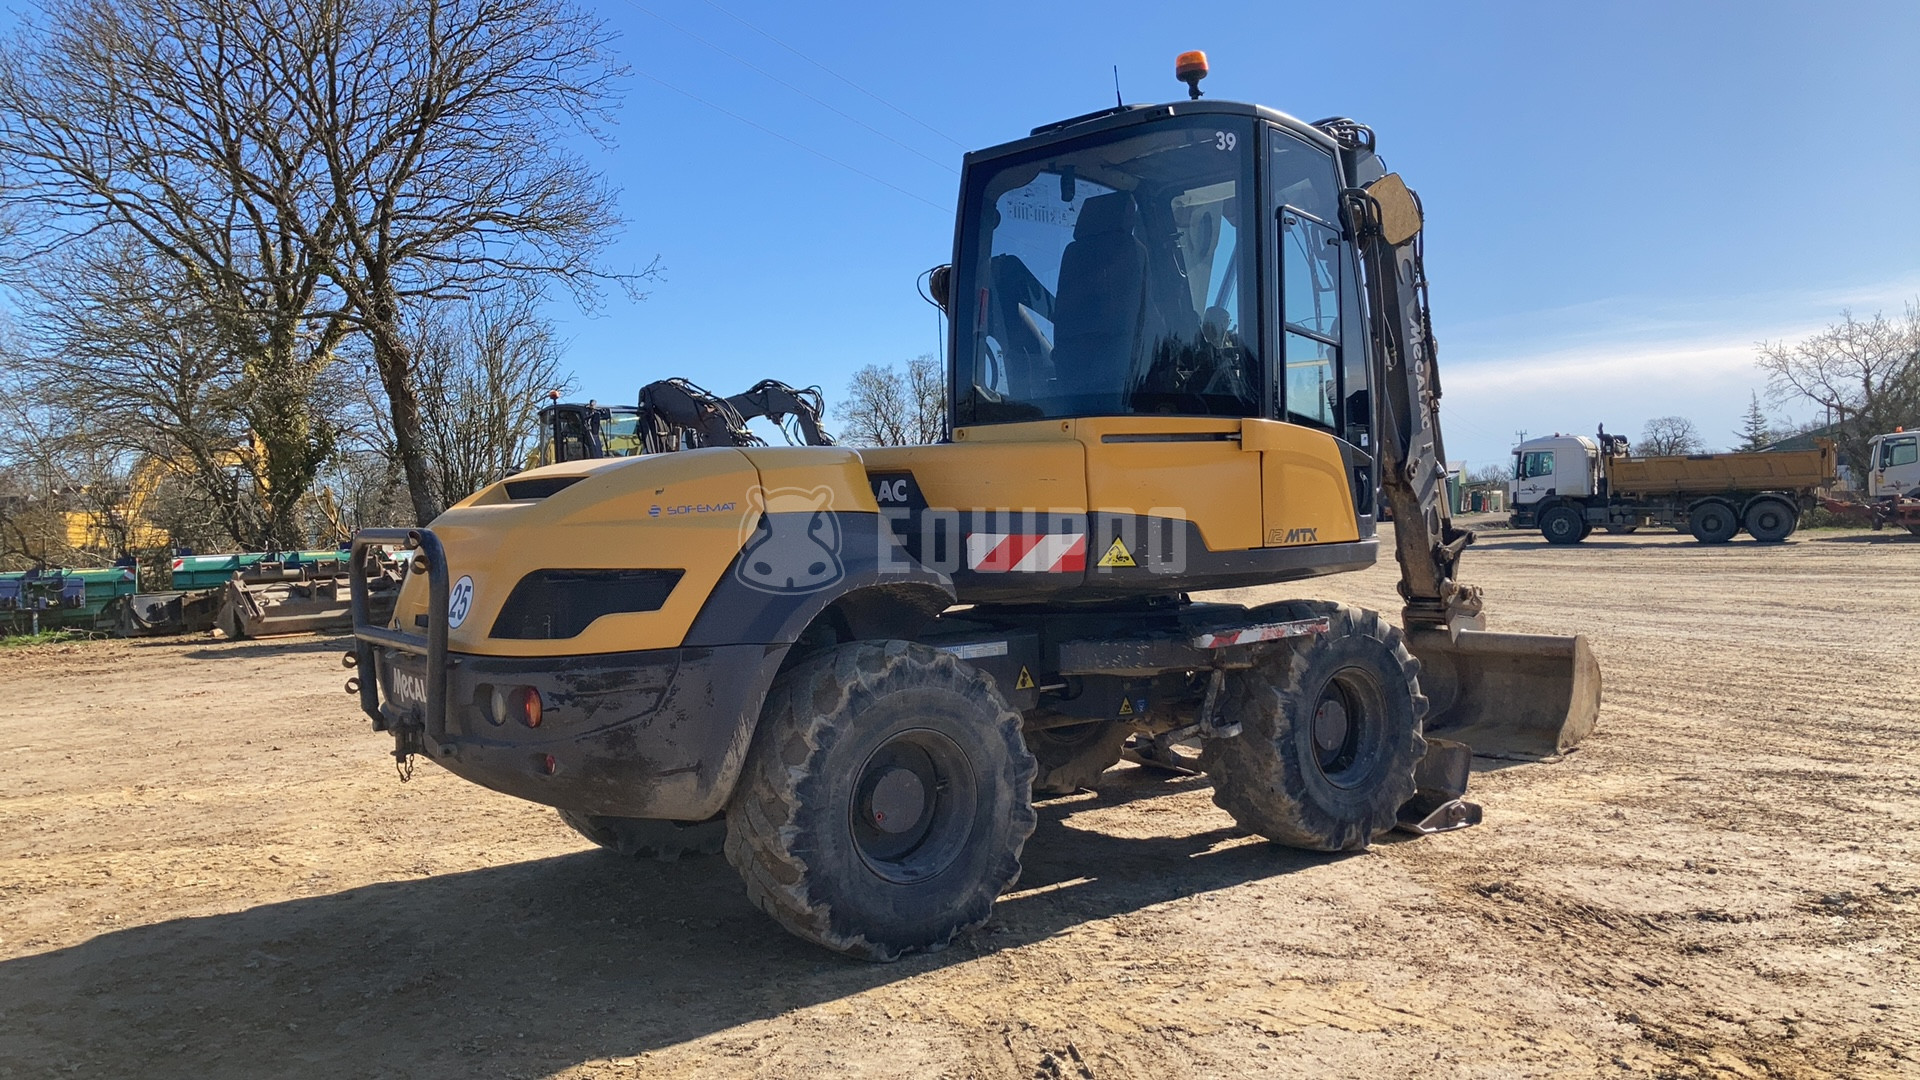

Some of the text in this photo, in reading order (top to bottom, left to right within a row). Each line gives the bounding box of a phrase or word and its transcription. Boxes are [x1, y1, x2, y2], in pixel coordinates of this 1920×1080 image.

[1215, 130, 1237, 151] 39
[873, 479, 908, 502] AC
[666, 502, 737, 516] SOFEMAT
[448, 583, 472, 621] 25
[393, 666, 427, 704] MeCAL
